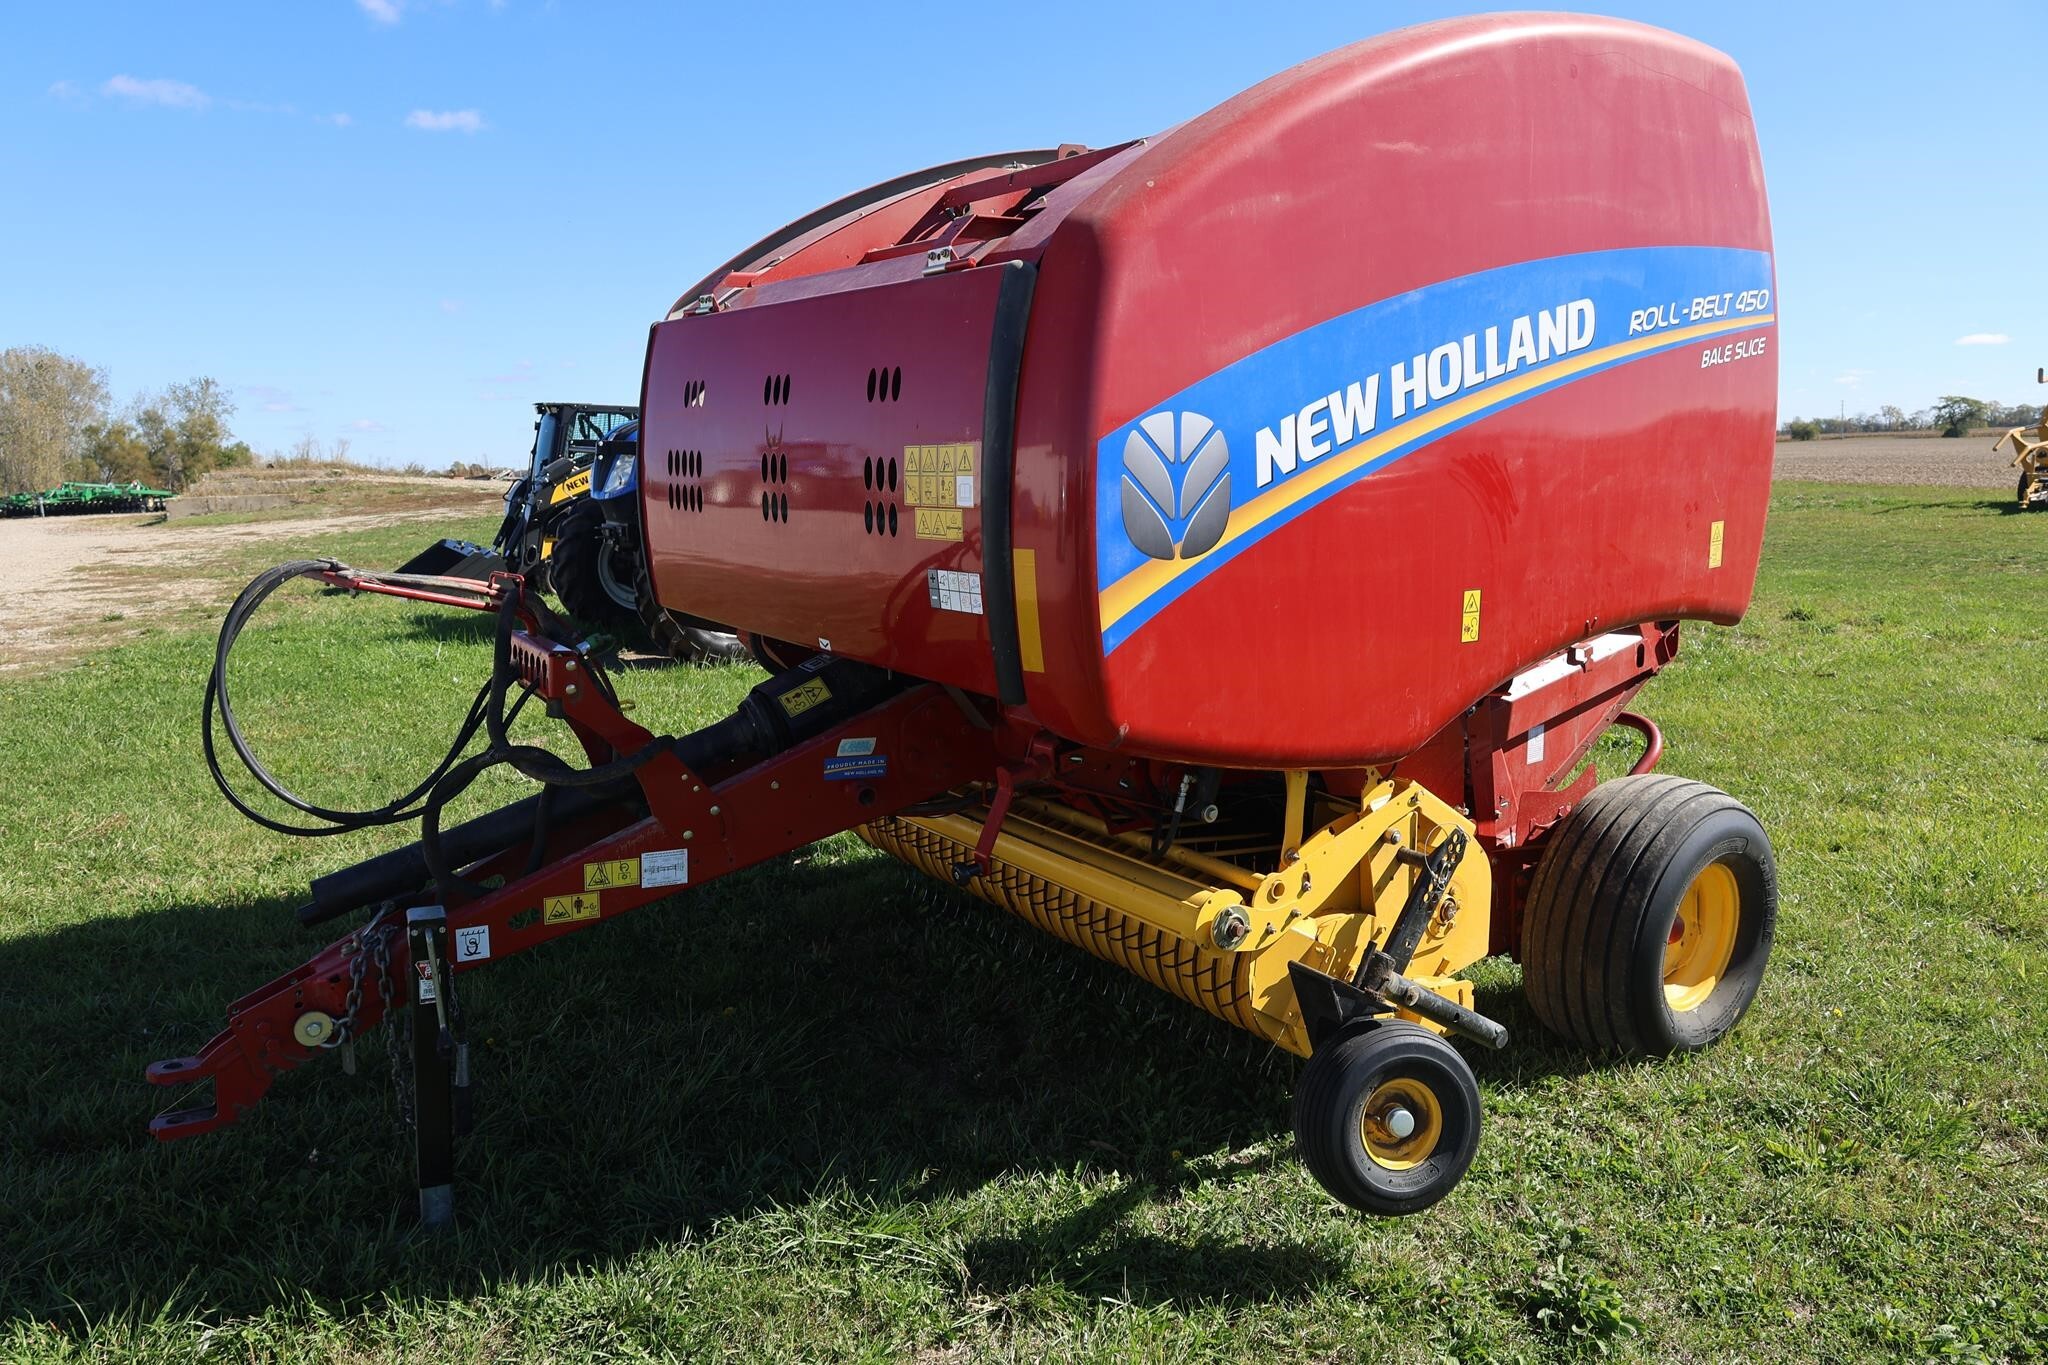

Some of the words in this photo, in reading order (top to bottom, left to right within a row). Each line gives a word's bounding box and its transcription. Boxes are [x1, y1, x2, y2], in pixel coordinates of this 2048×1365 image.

[1735, 289, 1769, 313] 450
[1701, 344, 1733, 368] BALE
[1734, 337, 1766, 360] SLICE
[1255, 373, 1379, 489] NEW
[1391, 298, 1596, 419] HOLLAND
[566, 475, 589, 491] NEW
